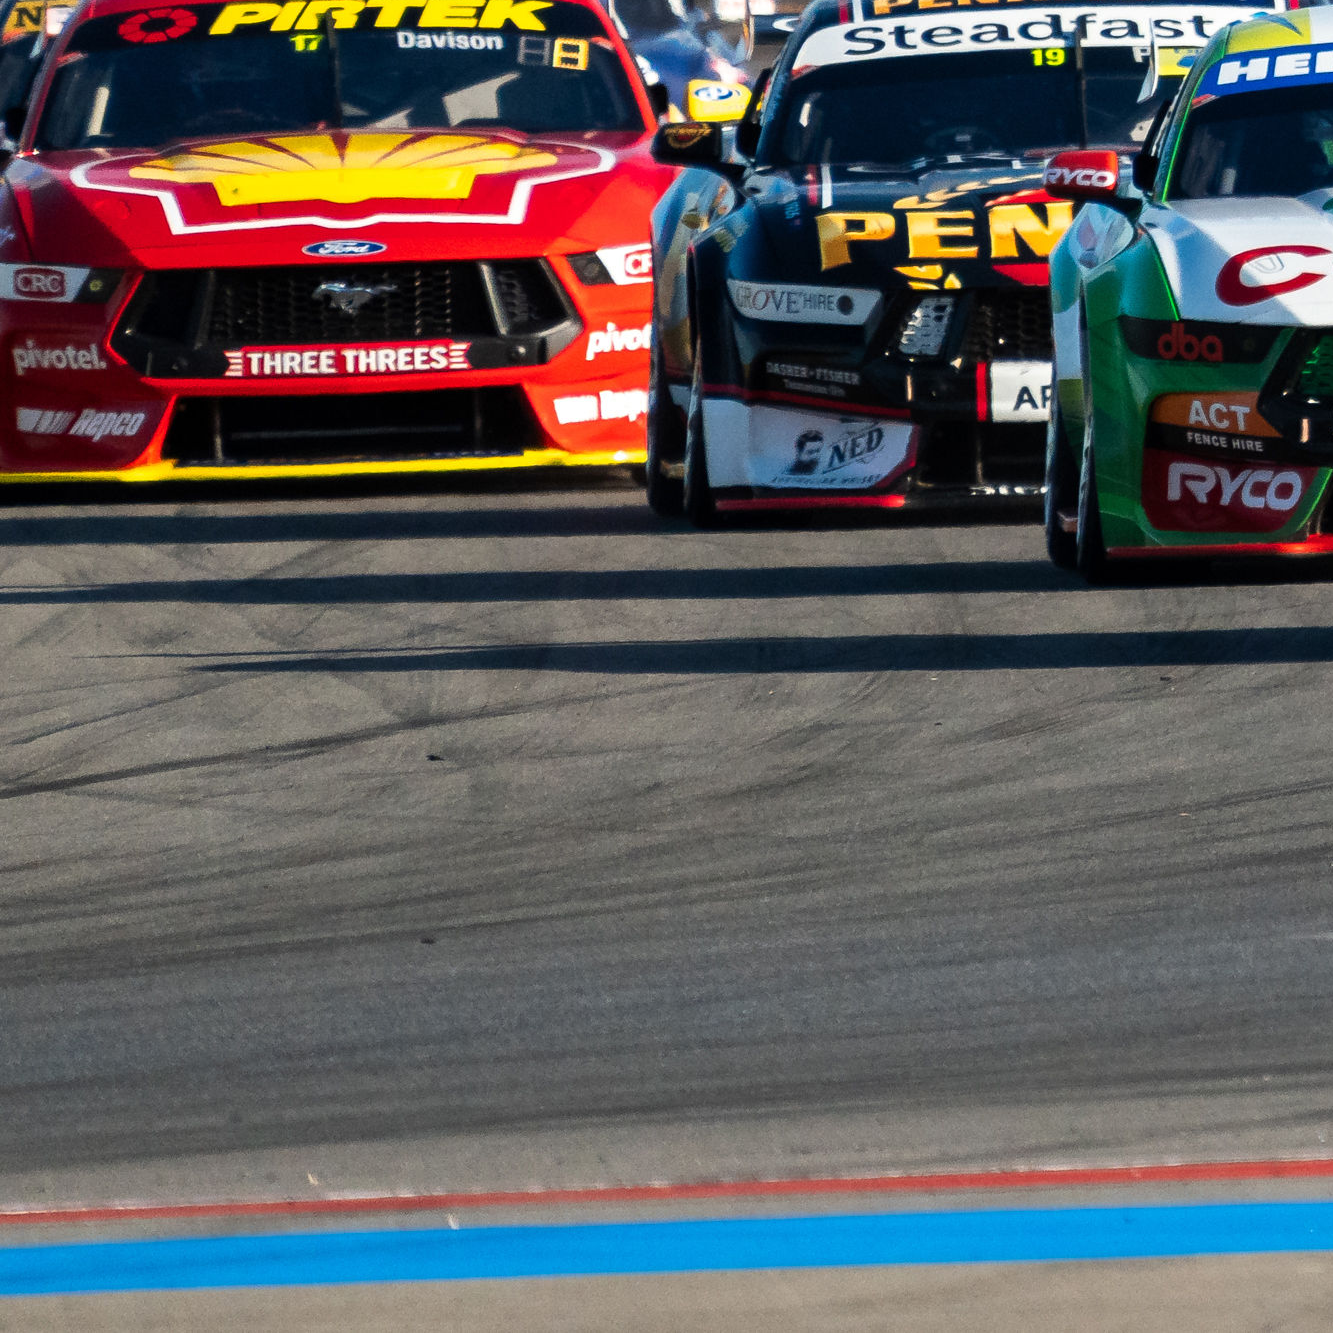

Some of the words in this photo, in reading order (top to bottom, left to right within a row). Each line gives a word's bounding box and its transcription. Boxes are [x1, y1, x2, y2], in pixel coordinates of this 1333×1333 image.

[290, 33, 323, 52] 17
[397, 31, 505, 51] Davison
[842, 11, 1212, 57] Steadfast
[1030, 47, 1067, 67] 19
[1042, 168, 1115, 188] RYCO
[317, 240, 373, 257] Ford
[16, 273, 62, 293] CRC
[1157, 322, 1224, 363] dba
[246, 350, 337, 376] THREE
[341, 345, 450, 374] THREES
[68, 407, 147, 443] Repco
[1187, 399, 1251, 433] ACT
[827, 426, 885, 467] NED
[1186, 430, 1228, 448] FENCE
[1231, 436, 1264, 453] HIRE
[1167, 461, 1302, 511] RYCO
